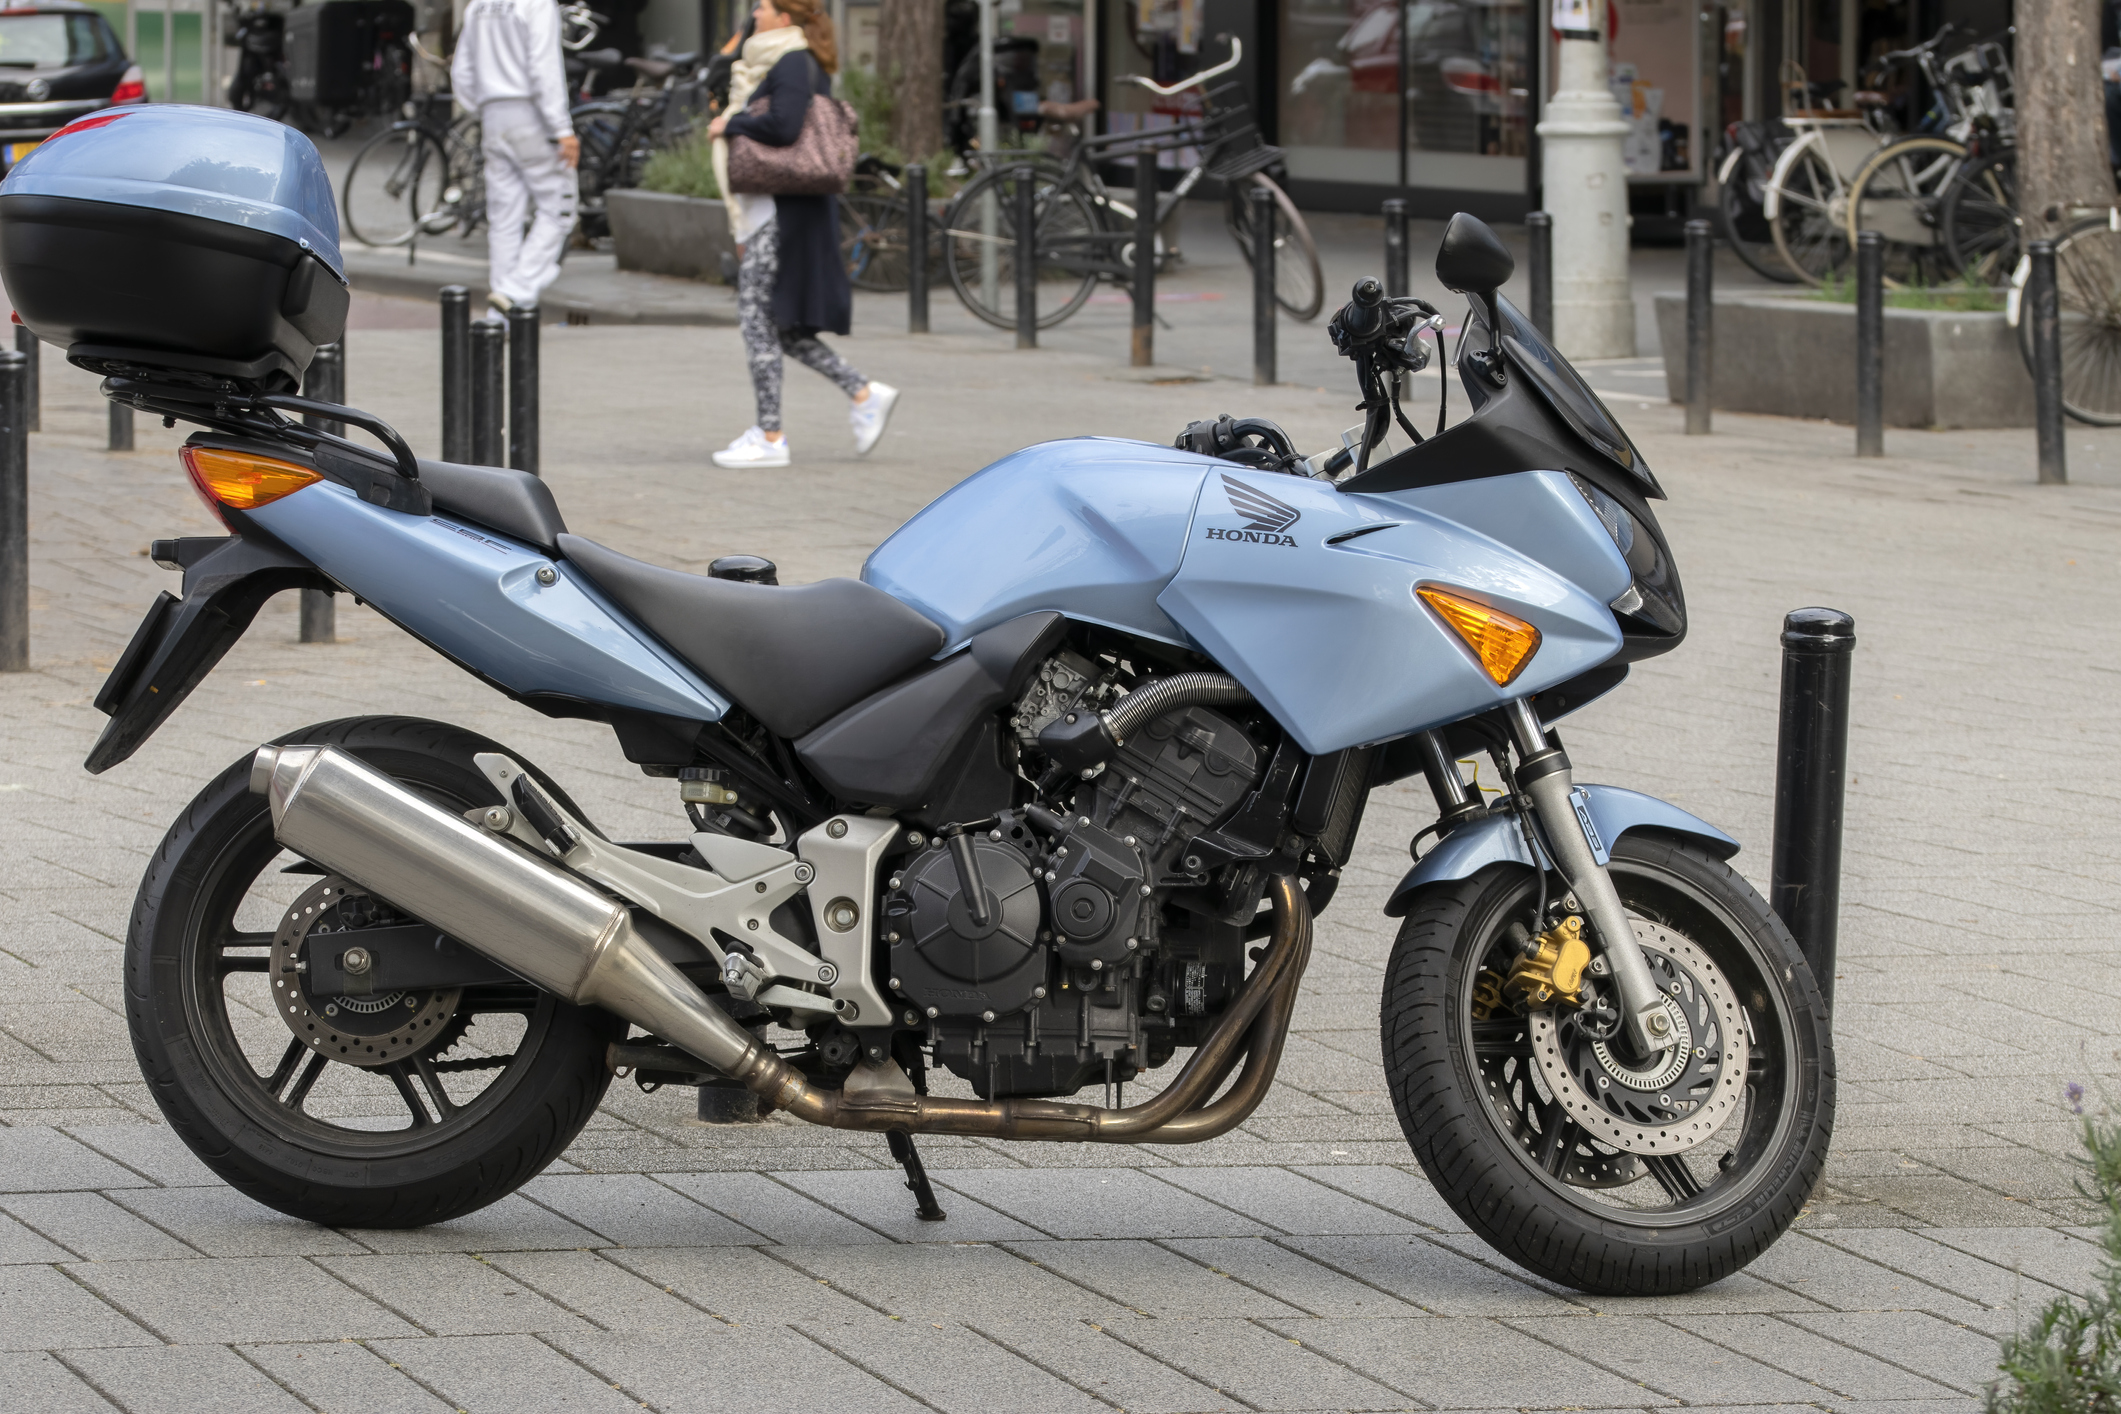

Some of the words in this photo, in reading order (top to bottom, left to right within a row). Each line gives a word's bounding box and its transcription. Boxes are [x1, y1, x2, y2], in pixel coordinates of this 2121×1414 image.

[1206, 528, 1299, 547] HONDA
[1579, 809, 1600, 848] ABS
[923, 987, 992, 1001] HONDA
[1752, 1139, 1805, 1208] MICHELIN
